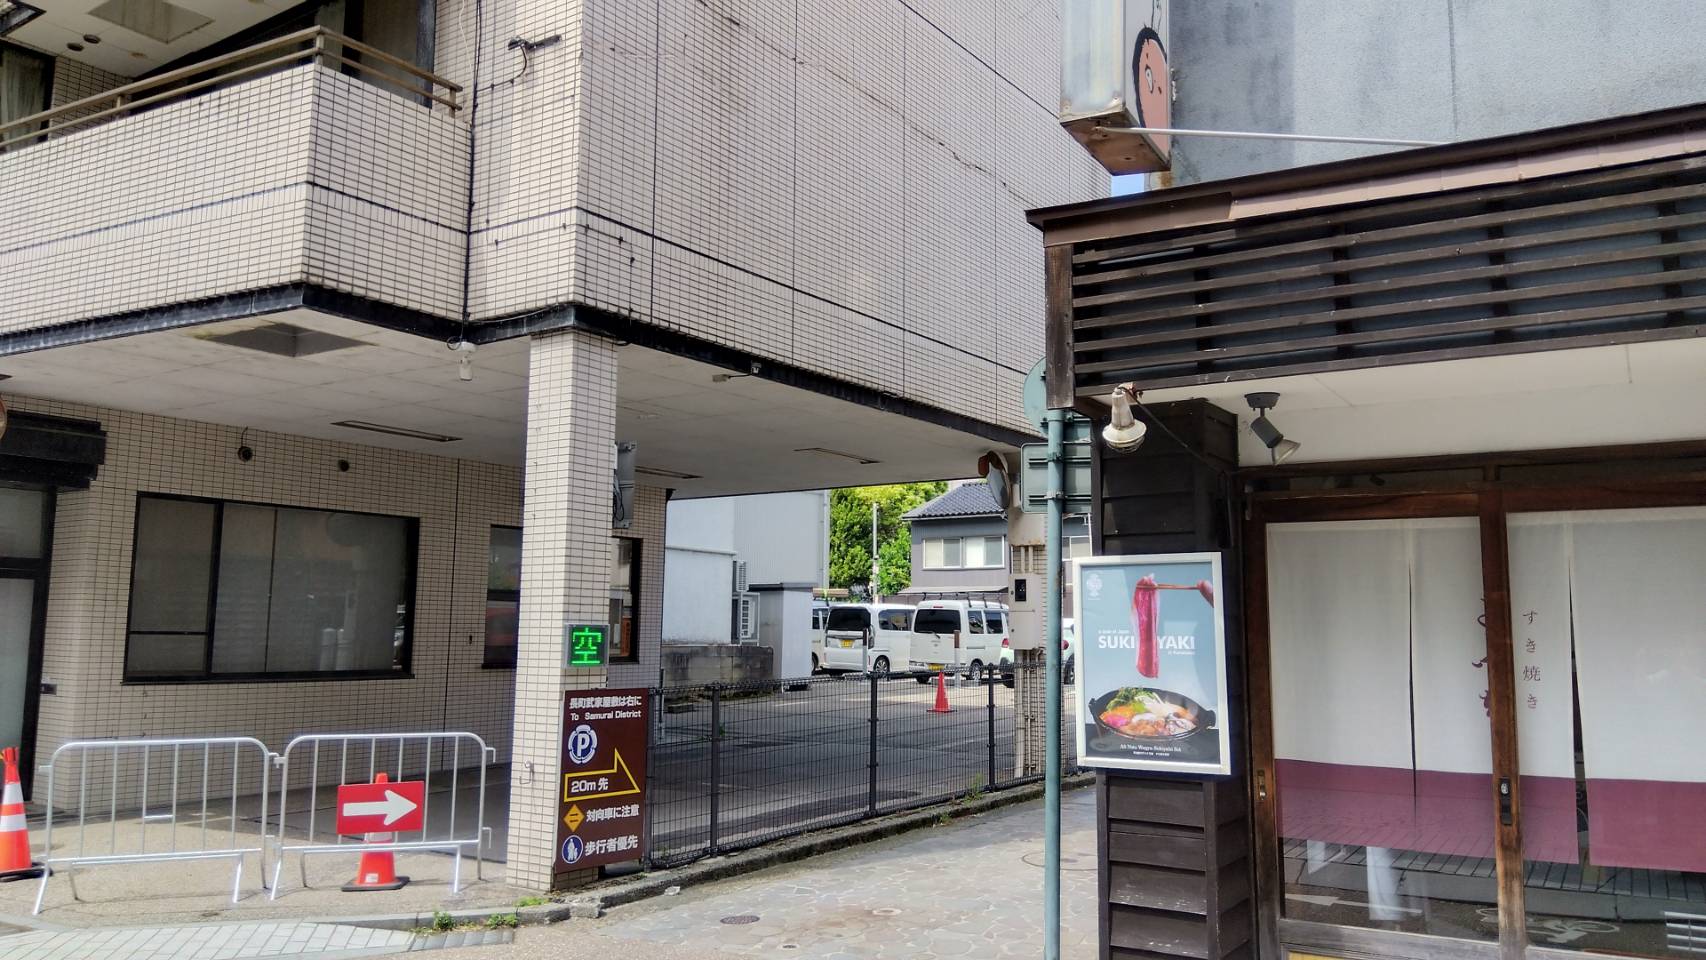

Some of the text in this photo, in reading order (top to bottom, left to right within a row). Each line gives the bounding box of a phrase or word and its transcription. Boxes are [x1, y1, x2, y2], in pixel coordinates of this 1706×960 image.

[571, 627, 602, 664] 空
[1098, 635, 1196, 650] SUKI YAKI
[1523, 610, 1541, 709] すき焼き
[570, 709, 642, 721] To Samurai District
[577, 733, 591, 757] P
[571, 777, 609, 793] 20m 先
[586, 804, 640, 822] 対向車に注意
[585, 834, 639, 856] 歩行者優先
